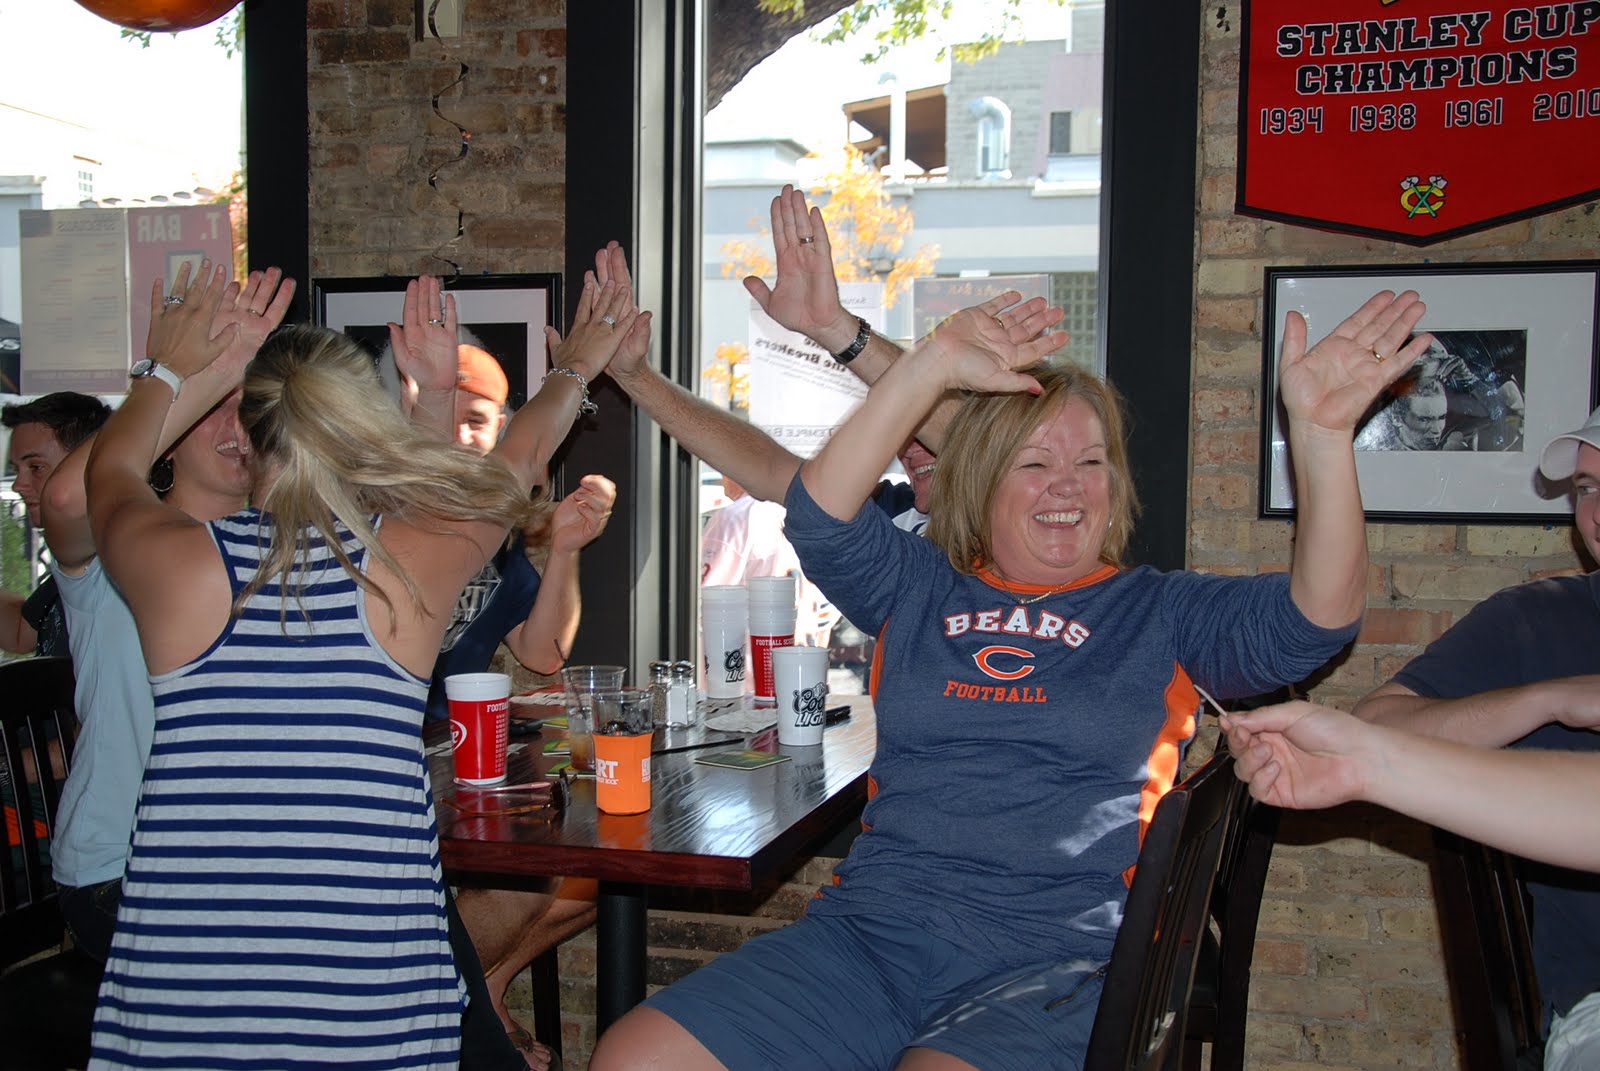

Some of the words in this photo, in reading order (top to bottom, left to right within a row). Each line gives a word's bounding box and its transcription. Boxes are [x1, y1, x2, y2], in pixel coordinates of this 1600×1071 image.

[1276, 11, 1491, 57] STANLEY
[1503, 1, 1600, 42] CUP
[1295, 46, 1577, 95] CHAMPIONS
[1260, 107, 1324, 135] 1934
[1350, 103, 1416, 132] 1938
[1444, 98, 1503, 128] 1961
[1532, 87, 1600, 121] 2010
[755, 638, 782, 646] FOOTBALL
[944, 606, 1092, 649] BEARS
[943, 680, 1048, 703] FOOTBALL
